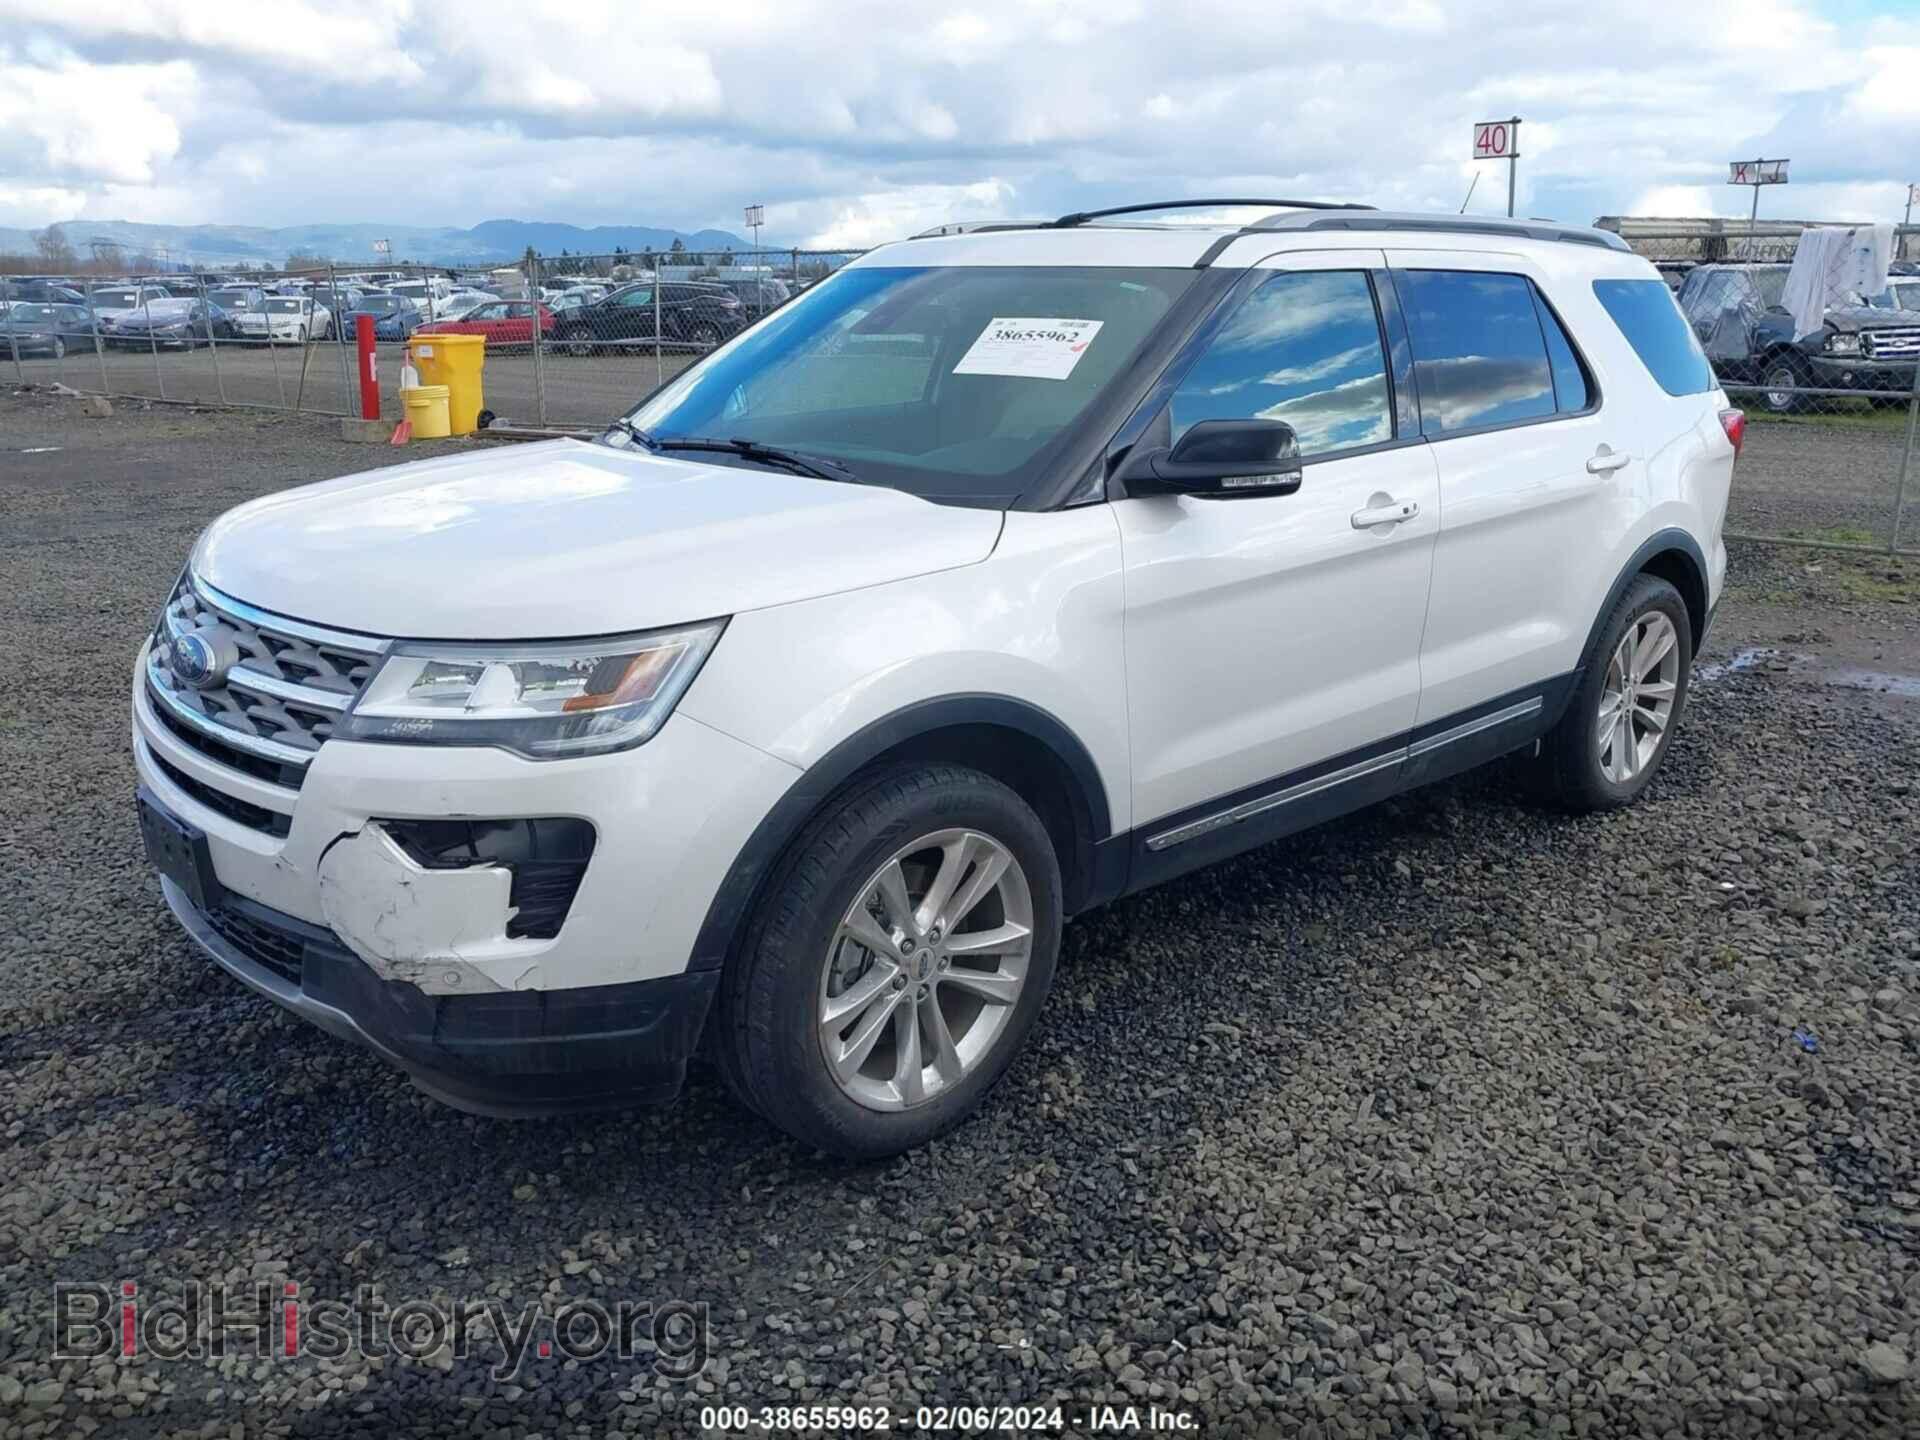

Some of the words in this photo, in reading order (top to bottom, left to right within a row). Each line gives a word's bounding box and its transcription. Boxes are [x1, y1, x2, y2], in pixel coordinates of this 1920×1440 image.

[1477, 125, 1506, 154] 40
[1734, 163, 1747, 183] K
[989, 329, 1080, 343] 38655962
